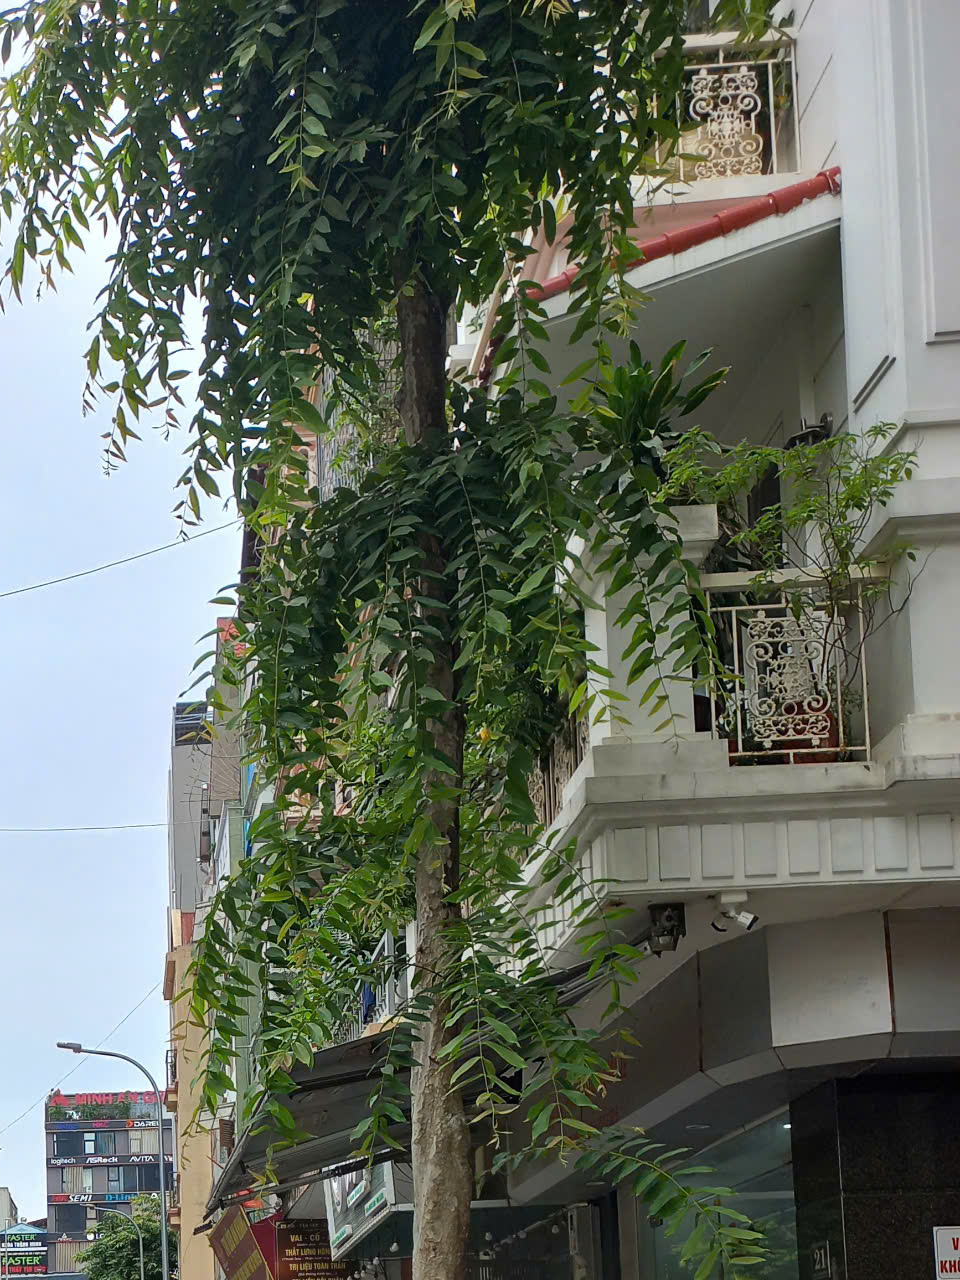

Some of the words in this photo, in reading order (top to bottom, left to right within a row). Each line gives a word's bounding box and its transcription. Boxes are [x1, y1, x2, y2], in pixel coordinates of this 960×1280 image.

[76, 1093, 113, 1105] MINH
[50, 1158, 76, 1166] logitech
[2, 1256, 40, 1265] FASTER
[814, 1248, 826, 1270] 21
